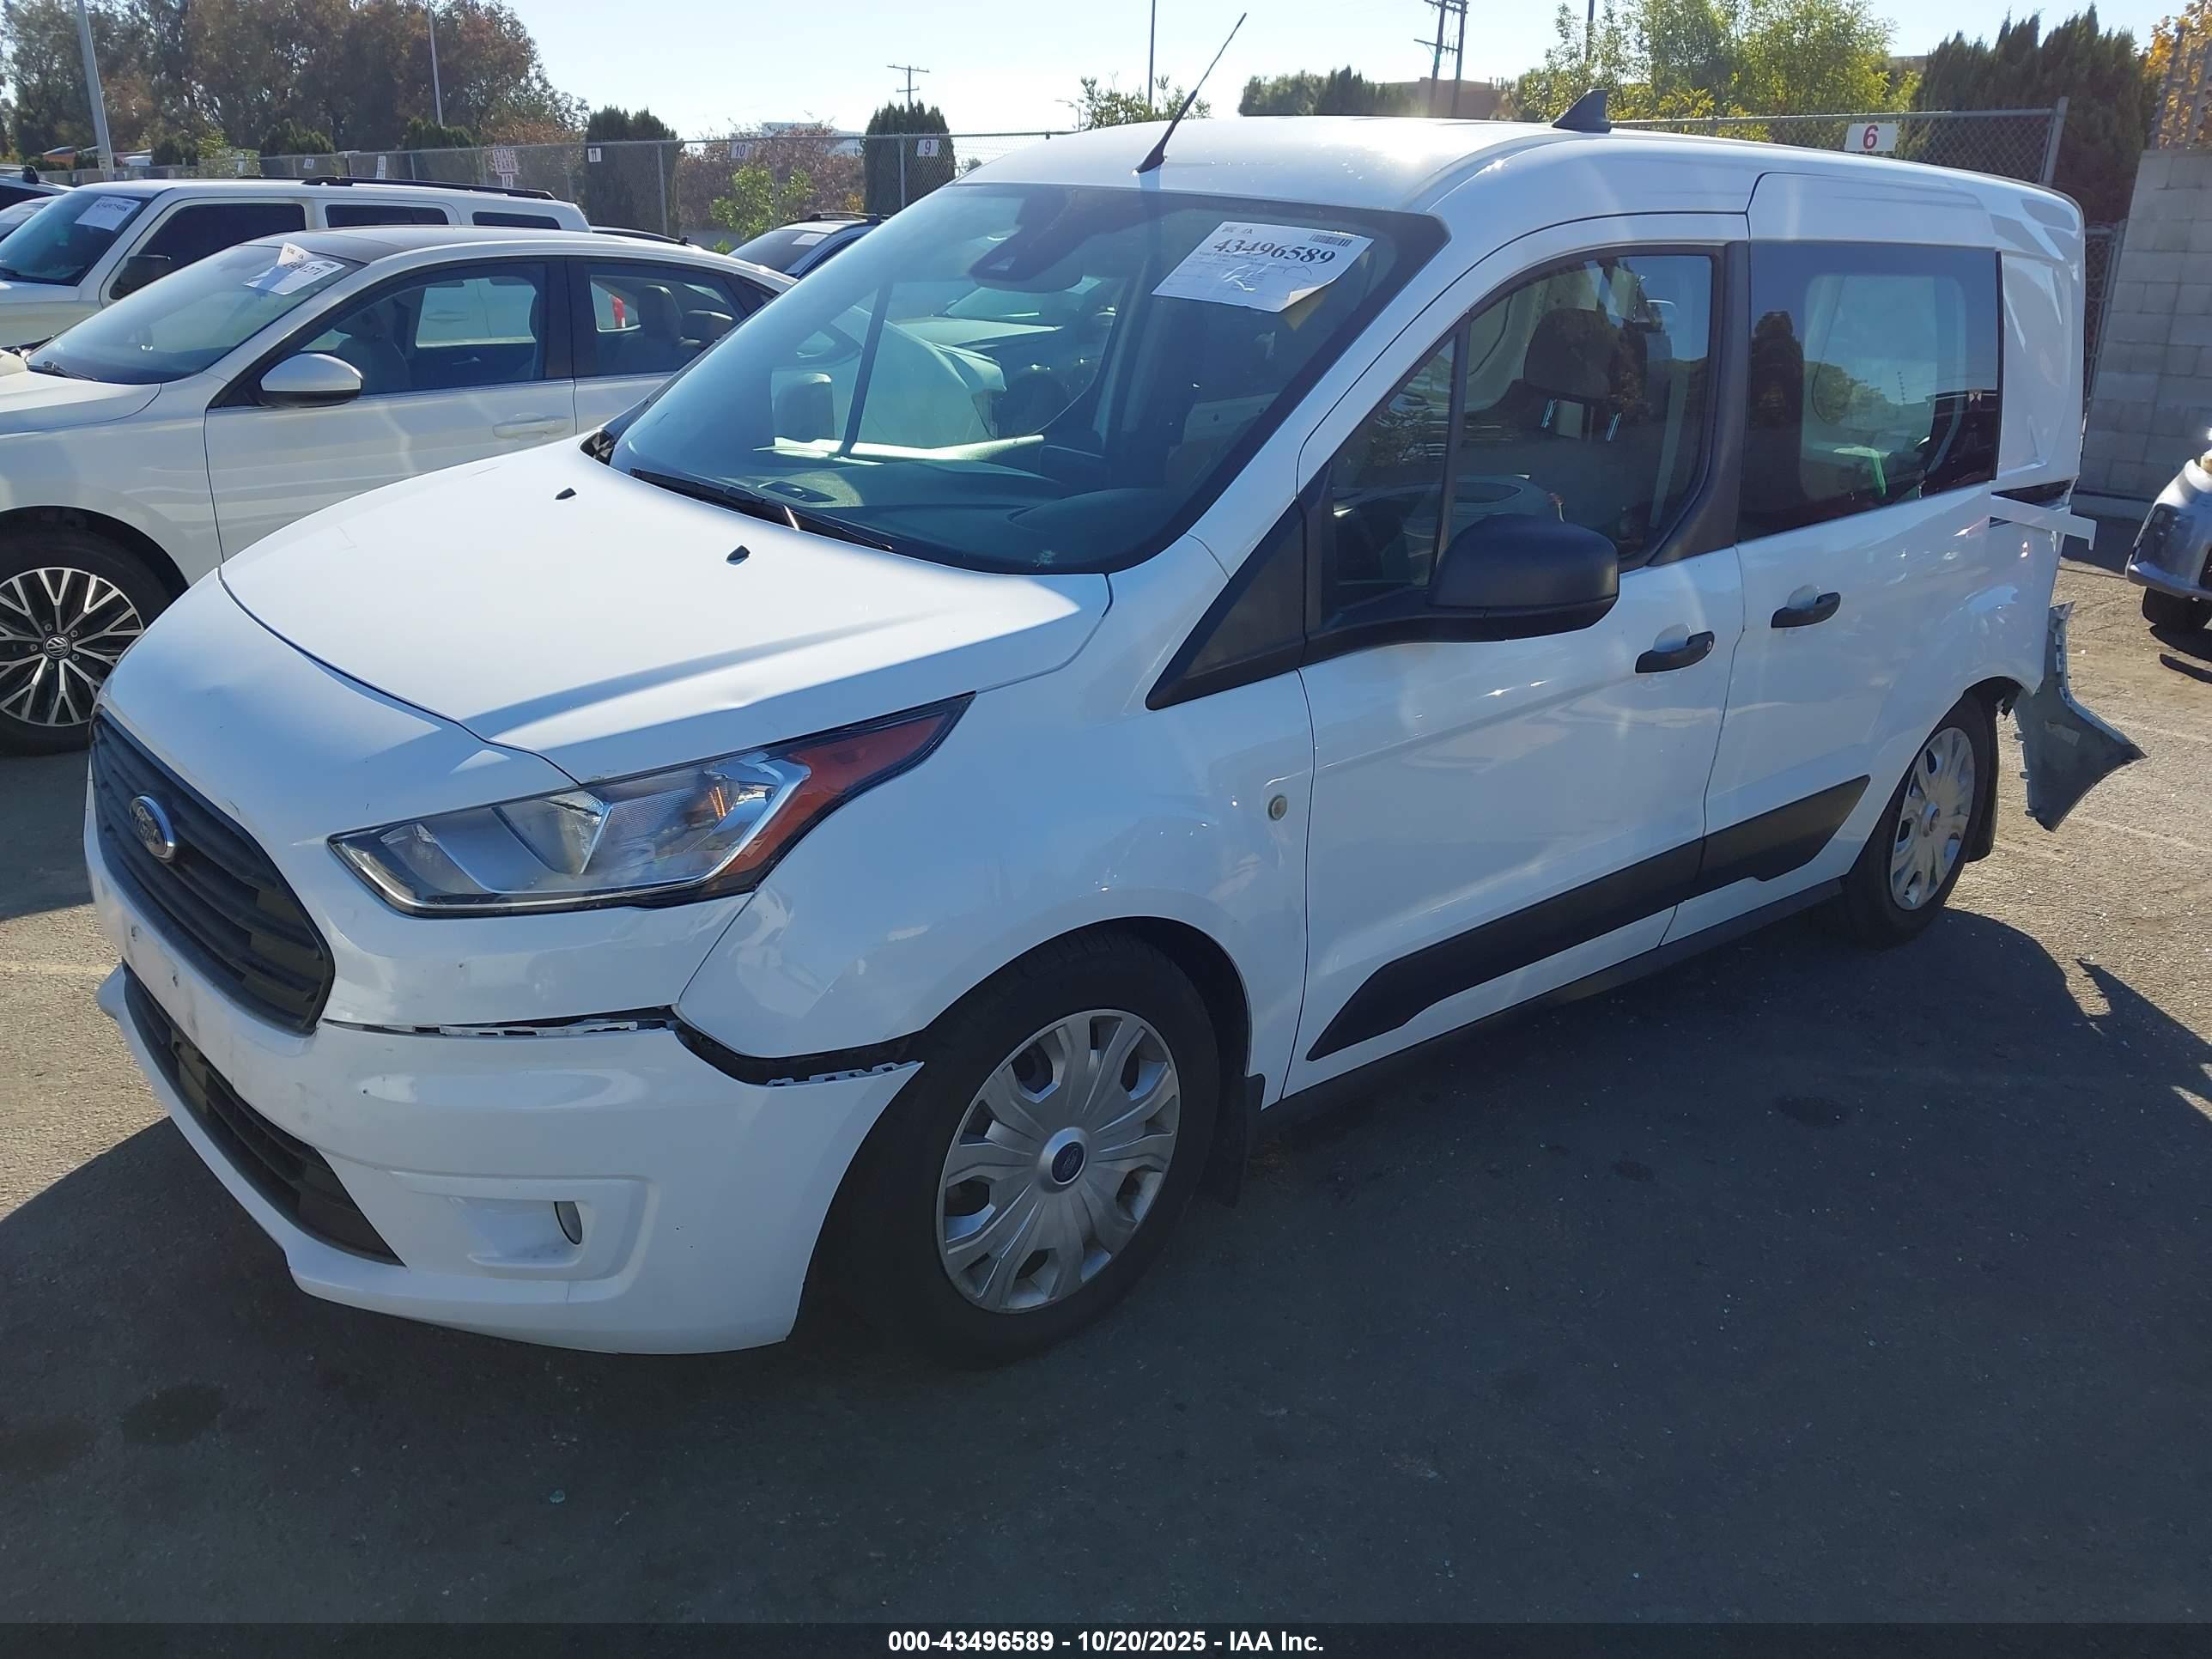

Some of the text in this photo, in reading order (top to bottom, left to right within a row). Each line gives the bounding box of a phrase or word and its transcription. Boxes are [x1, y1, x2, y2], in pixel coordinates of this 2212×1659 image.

[1863, 125, 1879, 149] 6
[494, 149, 515, 159] STATE
[735, 143, 746, 156] 10
[924, 140, 932, 155] 9
[497, 160, 518, 171] FARM
[1213, 238, 1336, 264] 43496589
